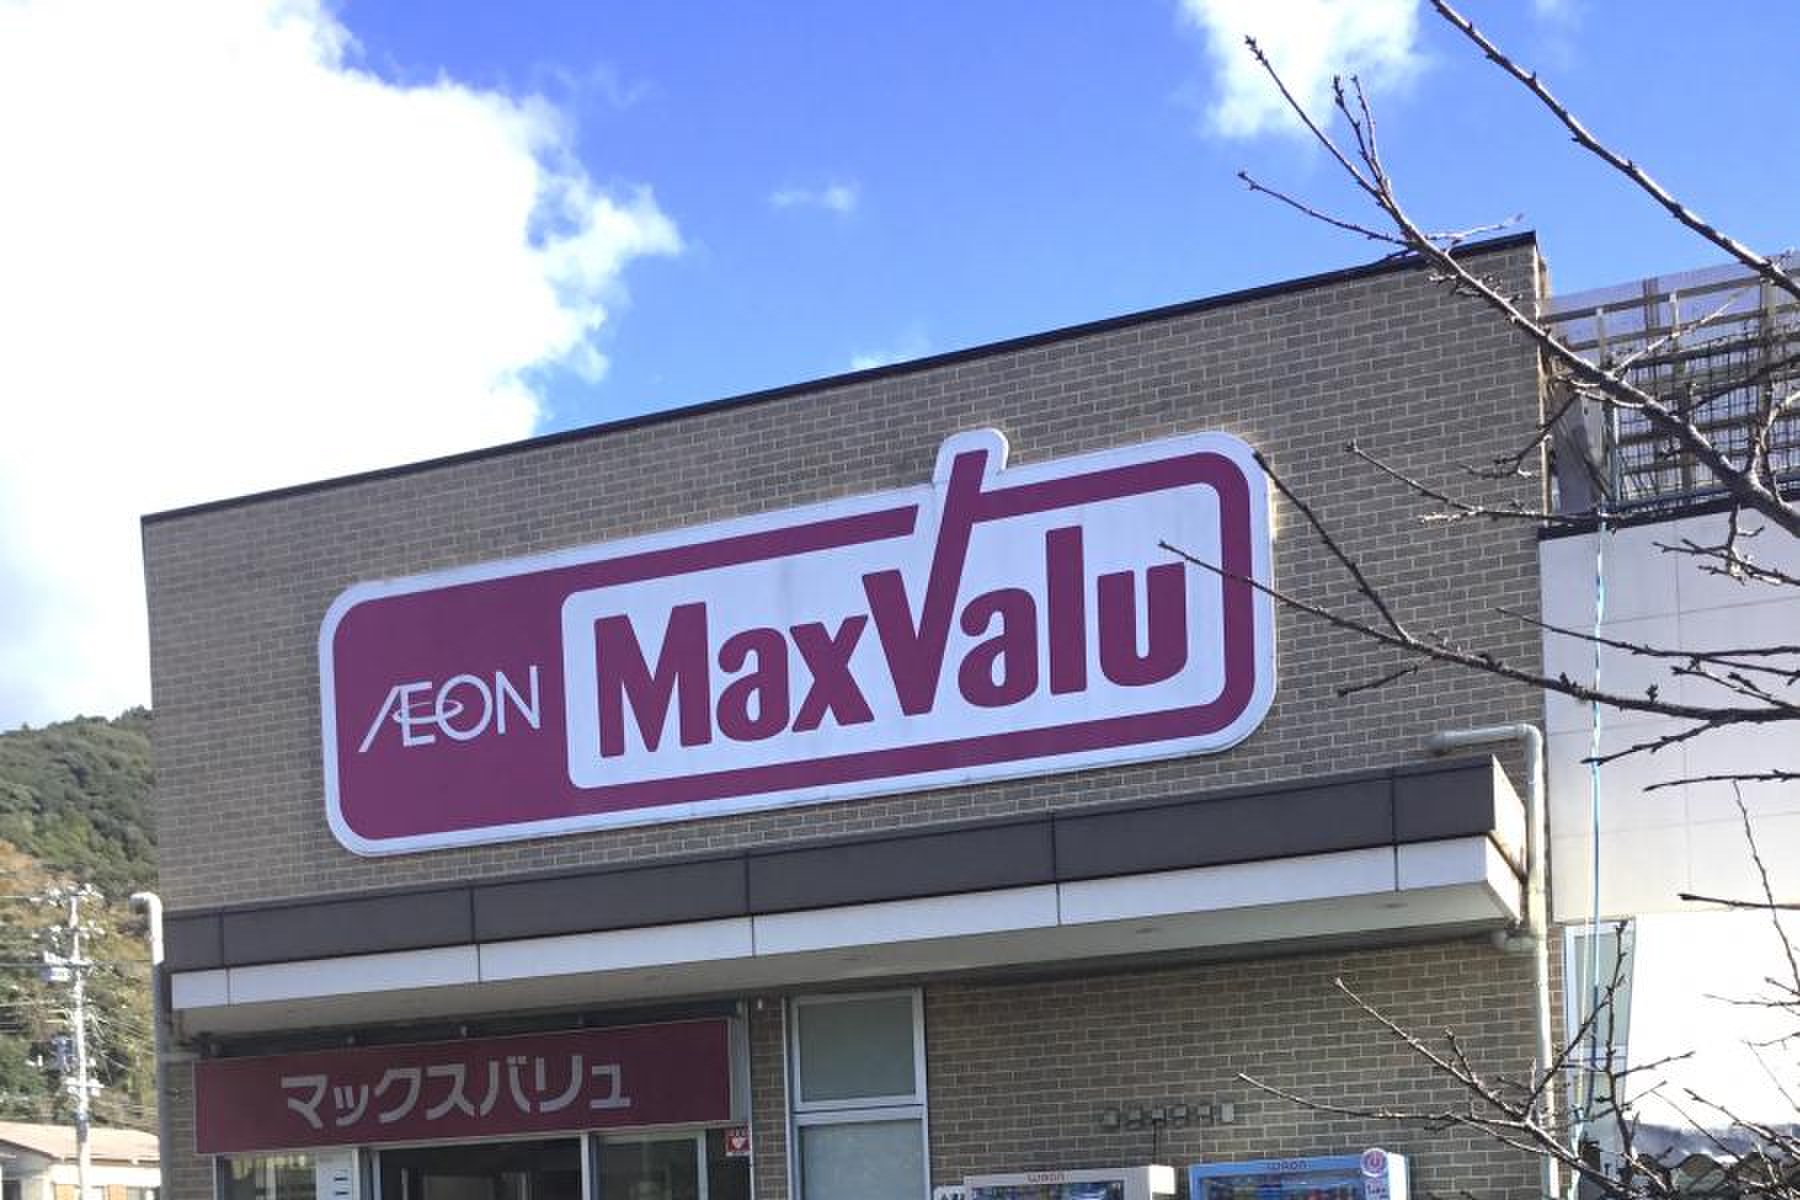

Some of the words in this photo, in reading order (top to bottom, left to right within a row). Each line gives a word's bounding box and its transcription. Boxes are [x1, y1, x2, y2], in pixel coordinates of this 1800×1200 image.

[593, 450, 1189, 758] MaxValu
[281, 1055, 631, 1129] マックスバリュ
